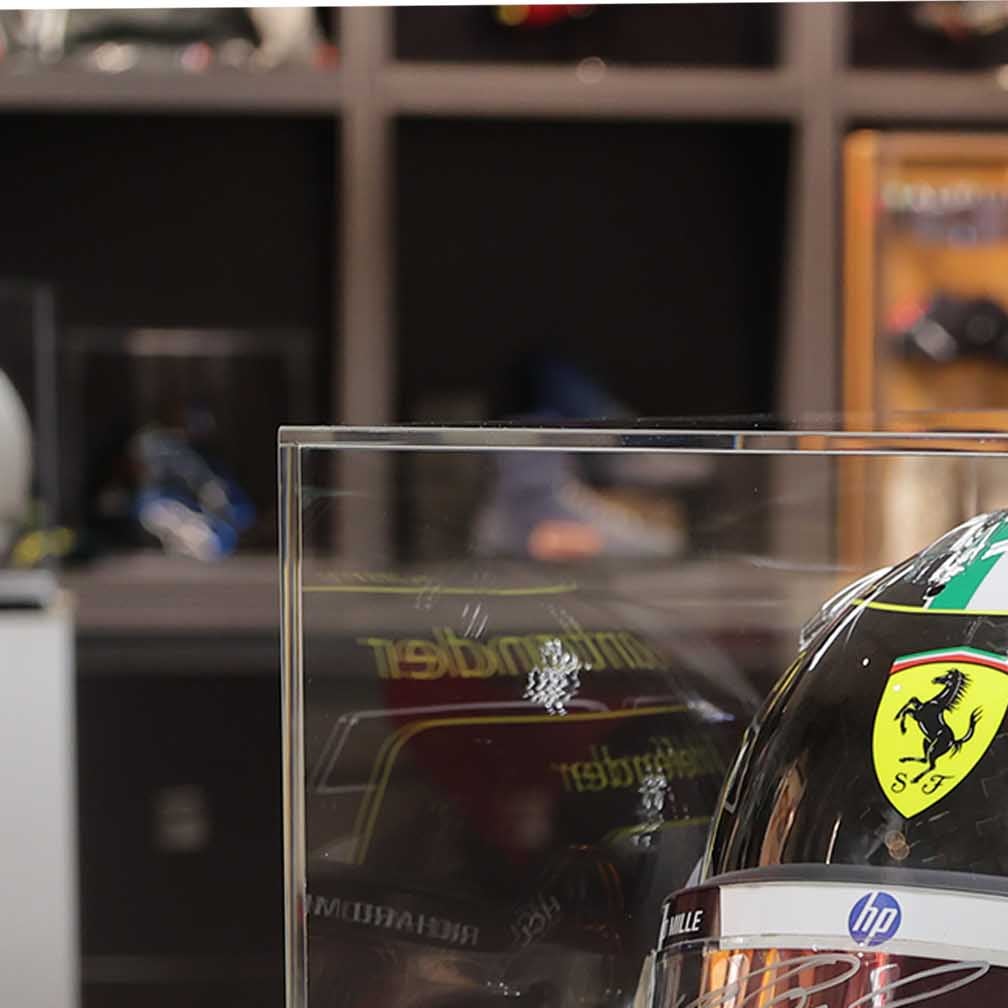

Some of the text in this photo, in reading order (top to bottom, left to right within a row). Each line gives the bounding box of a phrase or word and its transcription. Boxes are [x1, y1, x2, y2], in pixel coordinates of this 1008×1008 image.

[890, 772, 955, 795] S F
[668, 909, 703, 937] MILLE
[852, 891, 899, 945] hp
